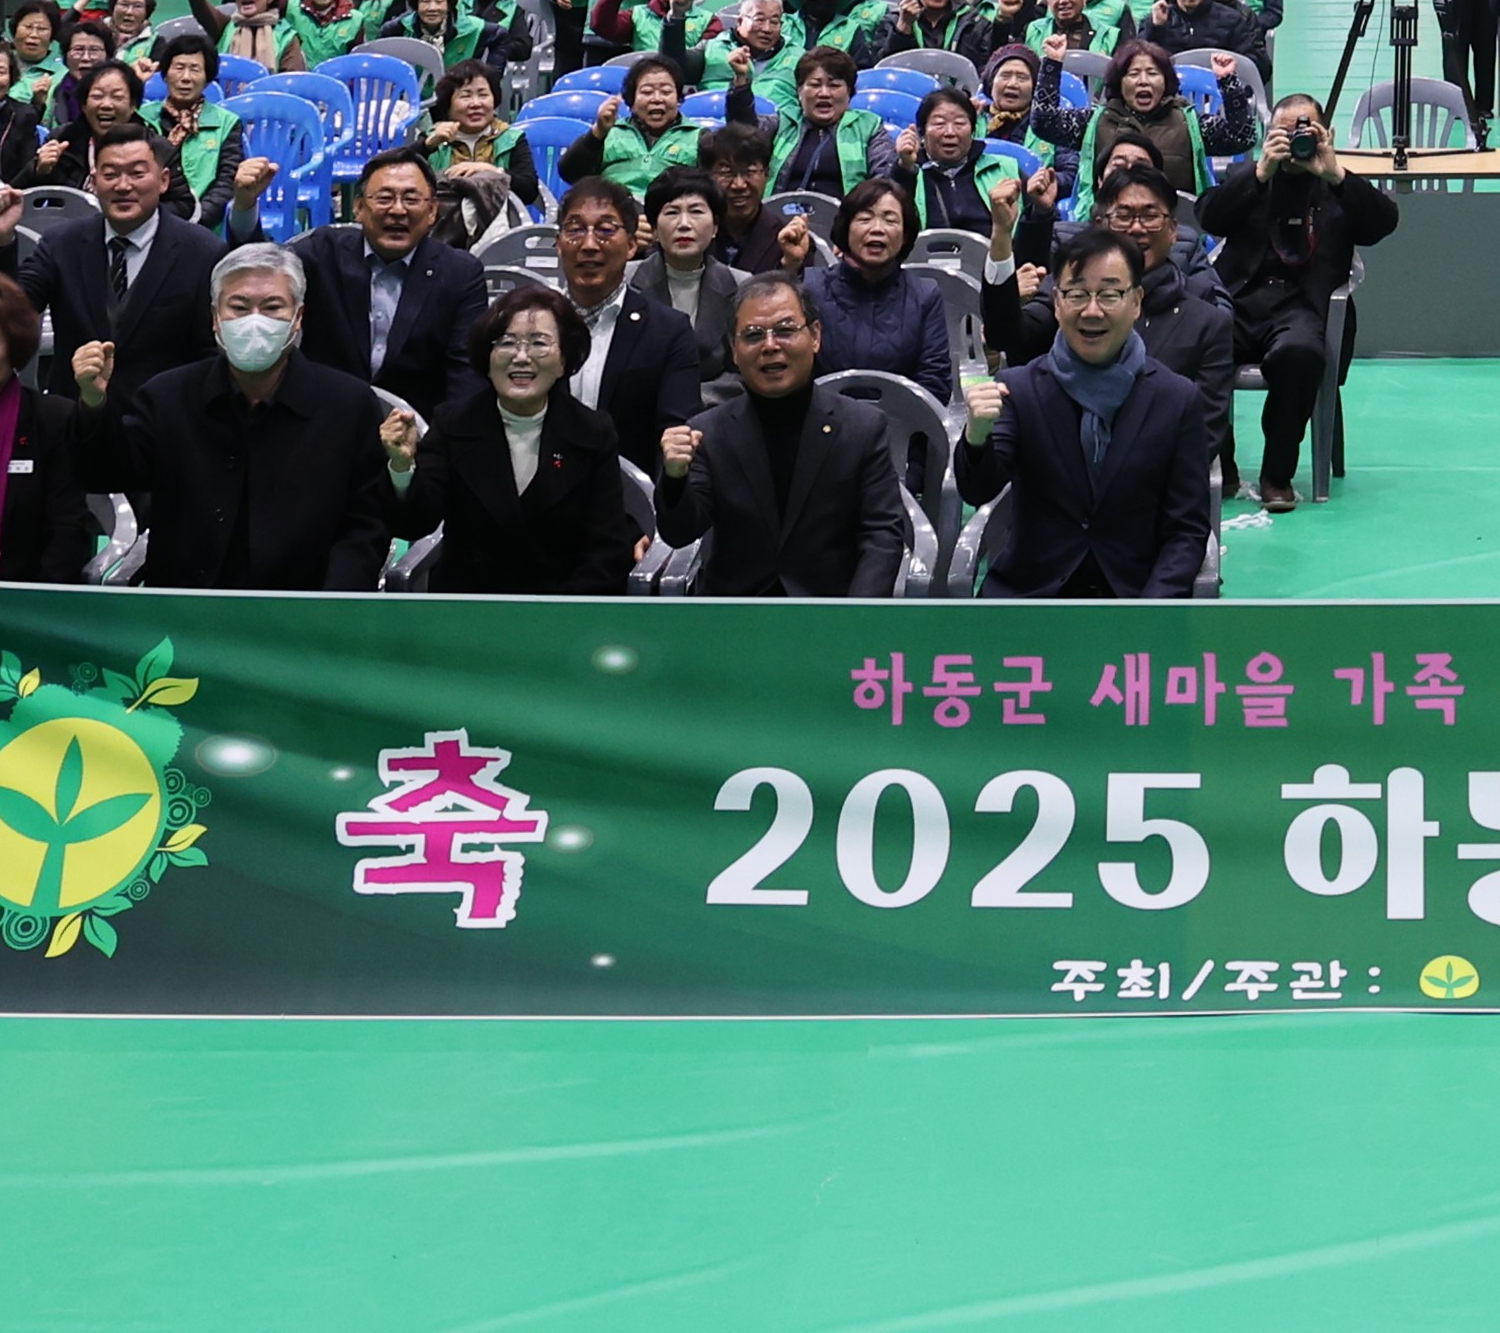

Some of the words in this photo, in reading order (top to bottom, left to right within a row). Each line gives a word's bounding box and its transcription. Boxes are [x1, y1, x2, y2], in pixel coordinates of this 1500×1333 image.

[852, 653, 1052, 727] 하동군
[1091, 653, 1294, 726] 새마을
[1335, 653, 1464, 724] 가족
[334, 728, 547, 929] 축
[706, 767, 1211, 910] 2025
